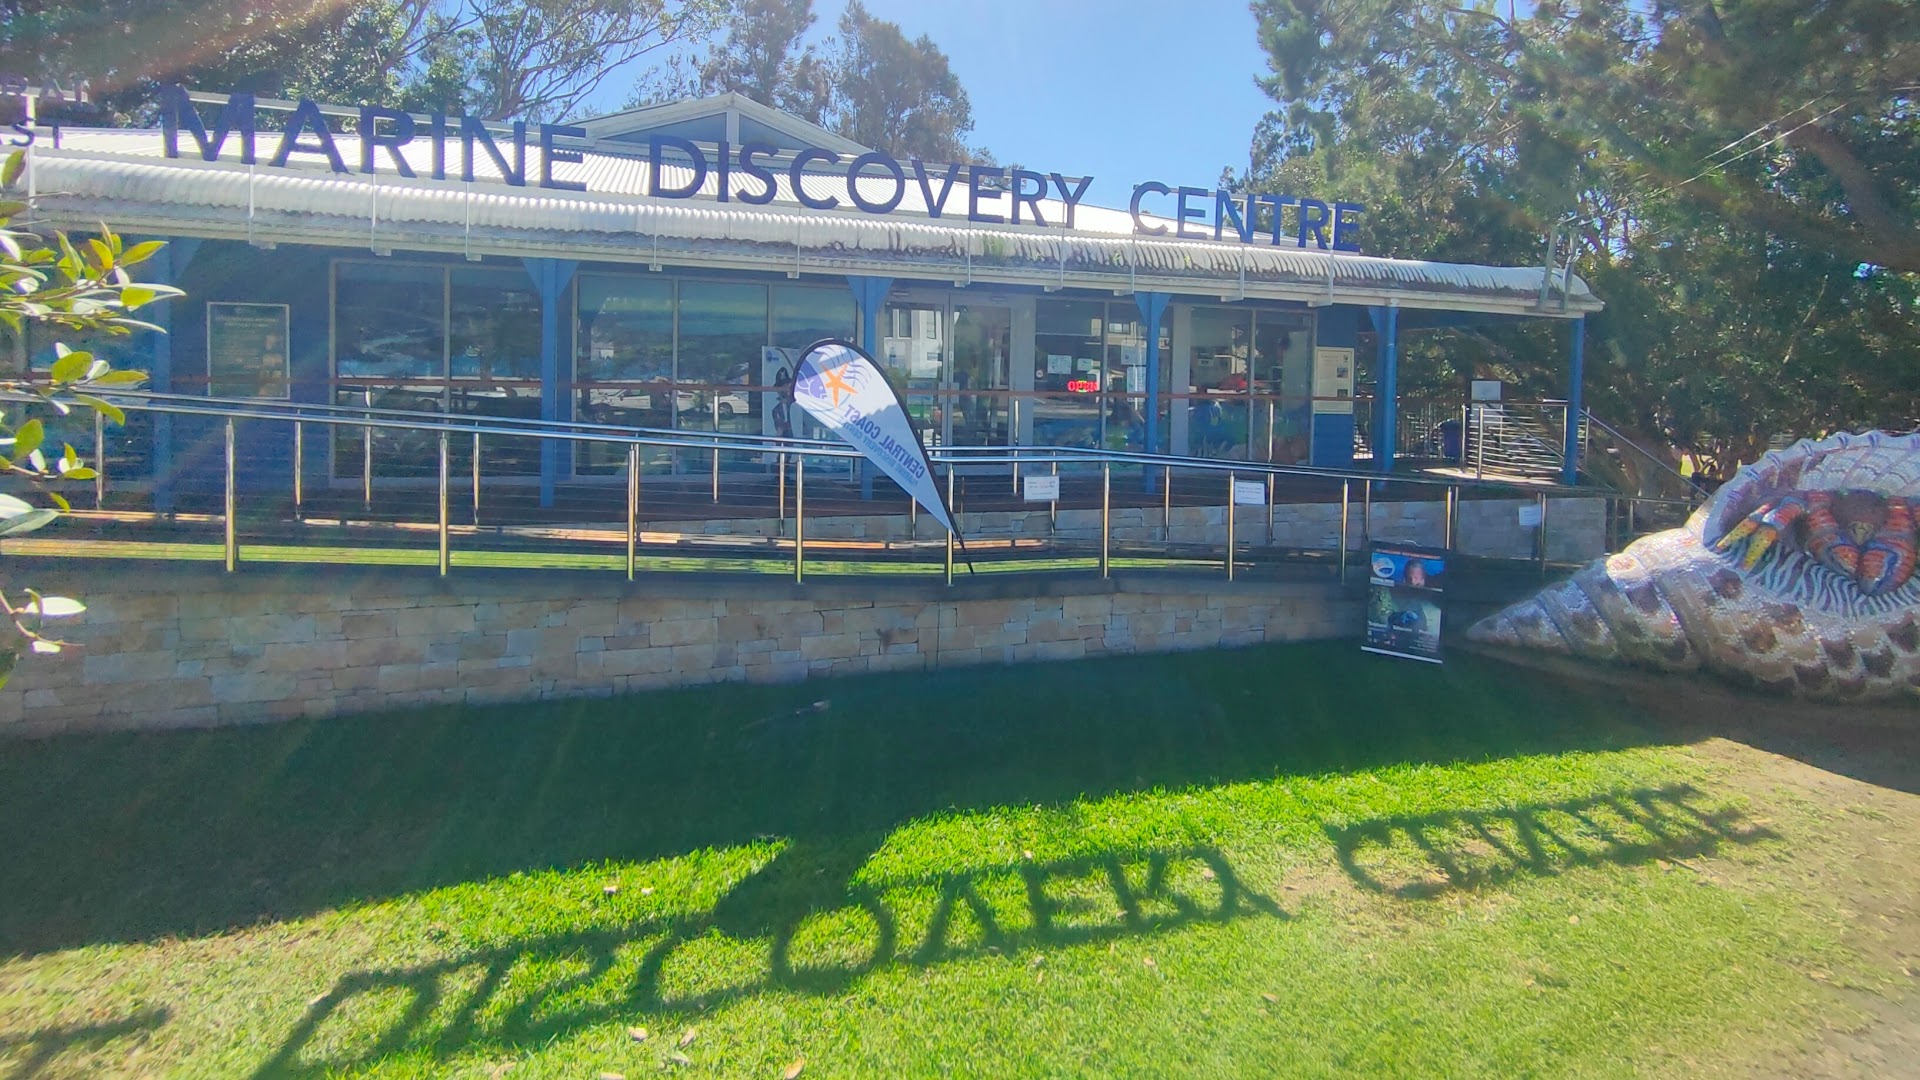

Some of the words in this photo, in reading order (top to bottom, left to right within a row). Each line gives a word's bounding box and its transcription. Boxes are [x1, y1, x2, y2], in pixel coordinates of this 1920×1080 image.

[163, 87, 587, 191] MARINE
[649, 134, 1092, 230] DISCOVERY
[1131, 180, 1365, 254] CENTRE
[1067, 380, 1098, 393] OPEN
